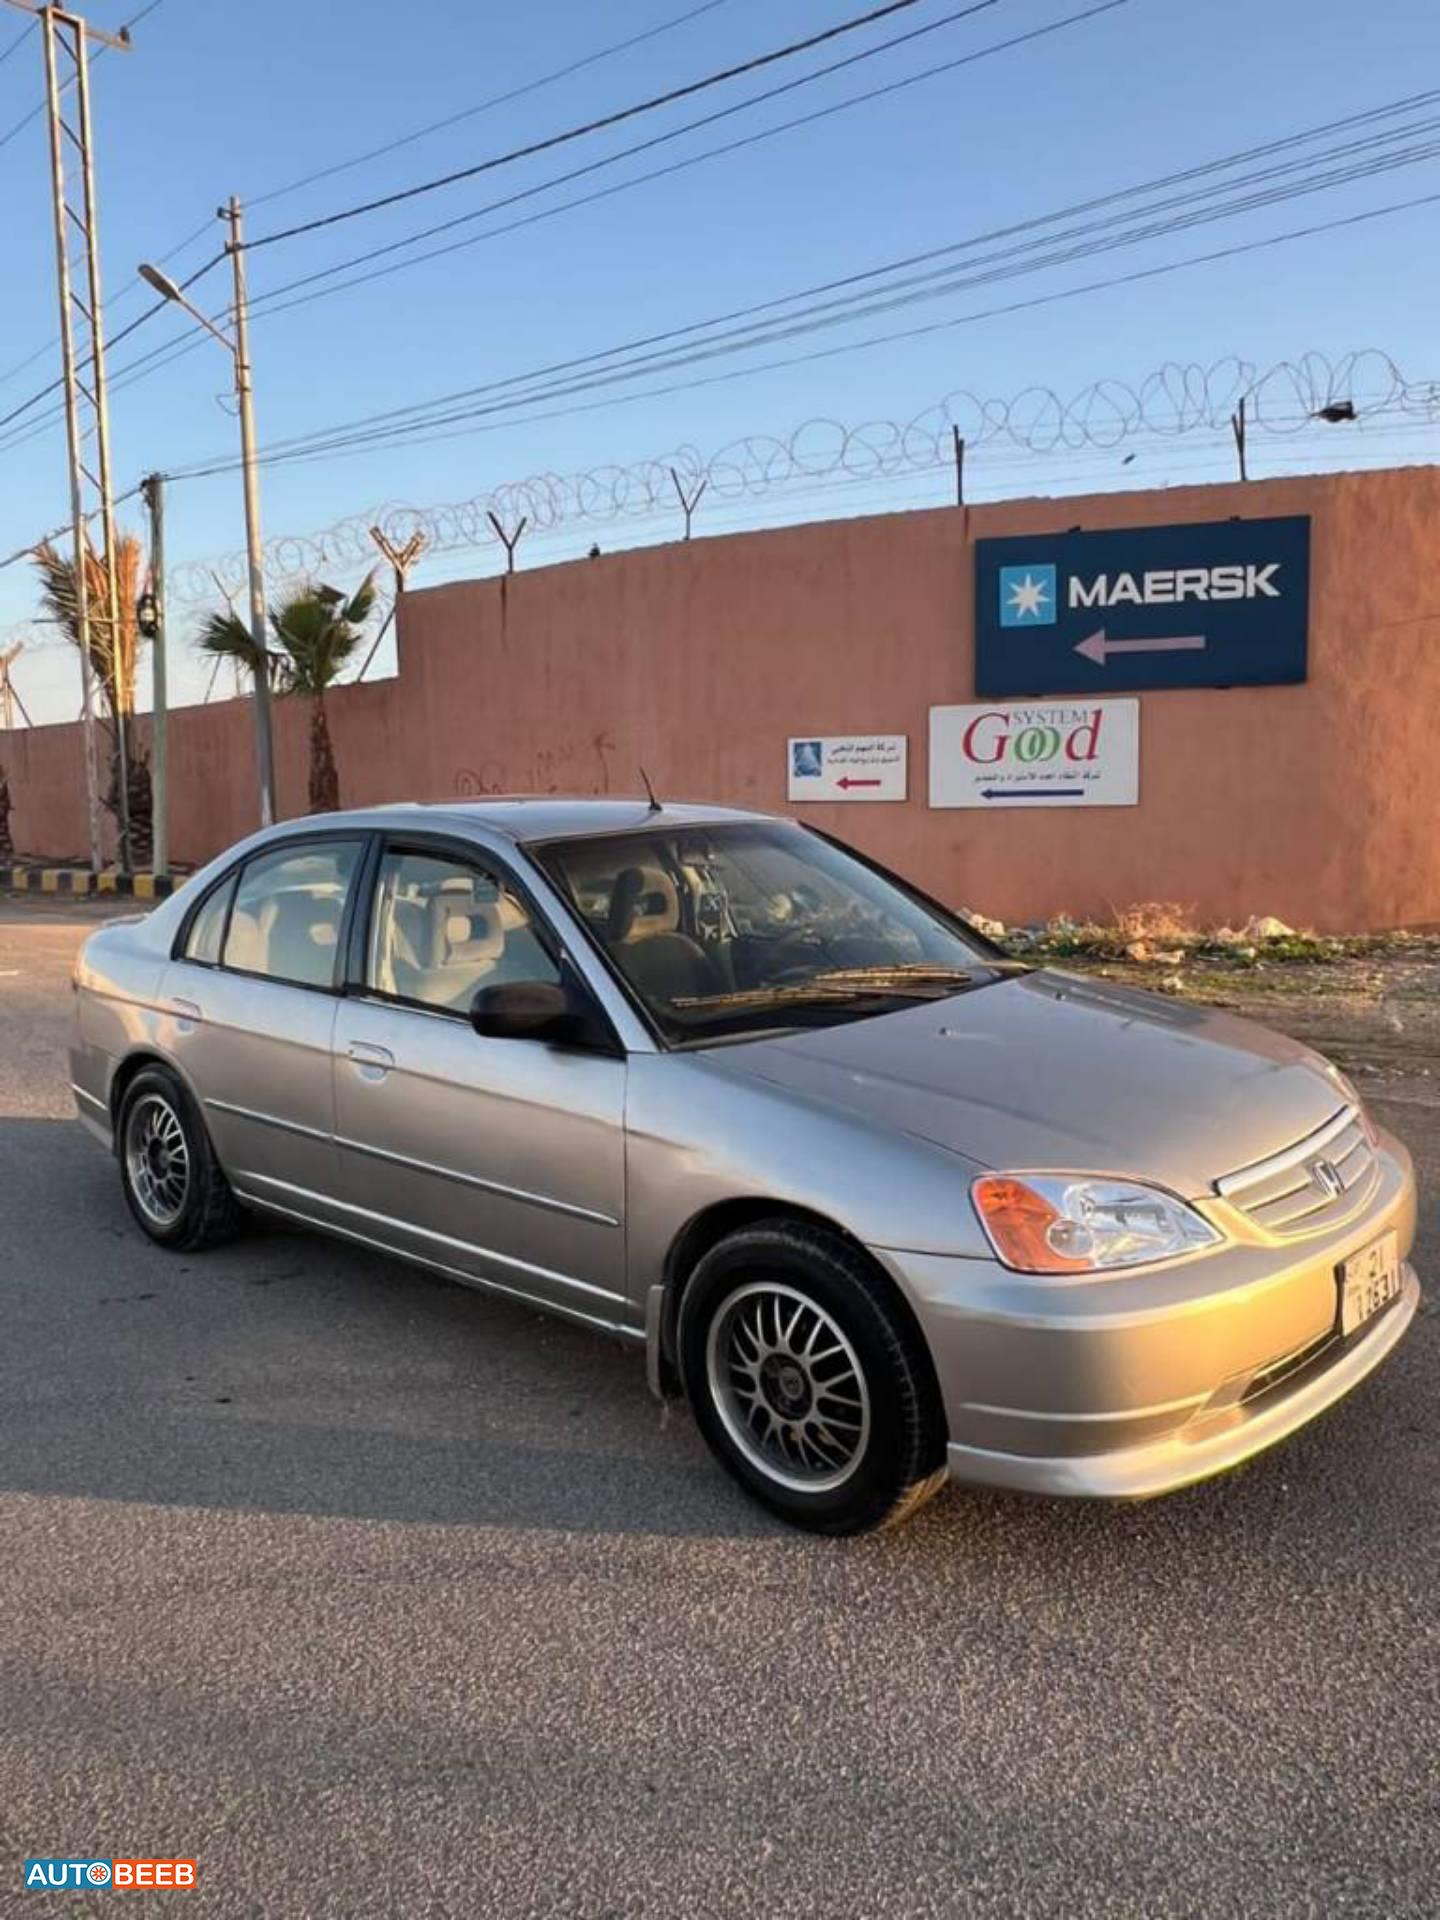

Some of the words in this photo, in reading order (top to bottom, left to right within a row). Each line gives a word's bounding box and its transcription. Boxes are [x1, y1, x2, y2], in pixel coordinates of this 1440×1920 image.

[1068, 564, 1281, 608] MAERSK
[961, 708, 1103, 764] Good
[1012, 708, 1089, 725] SYSTEM
